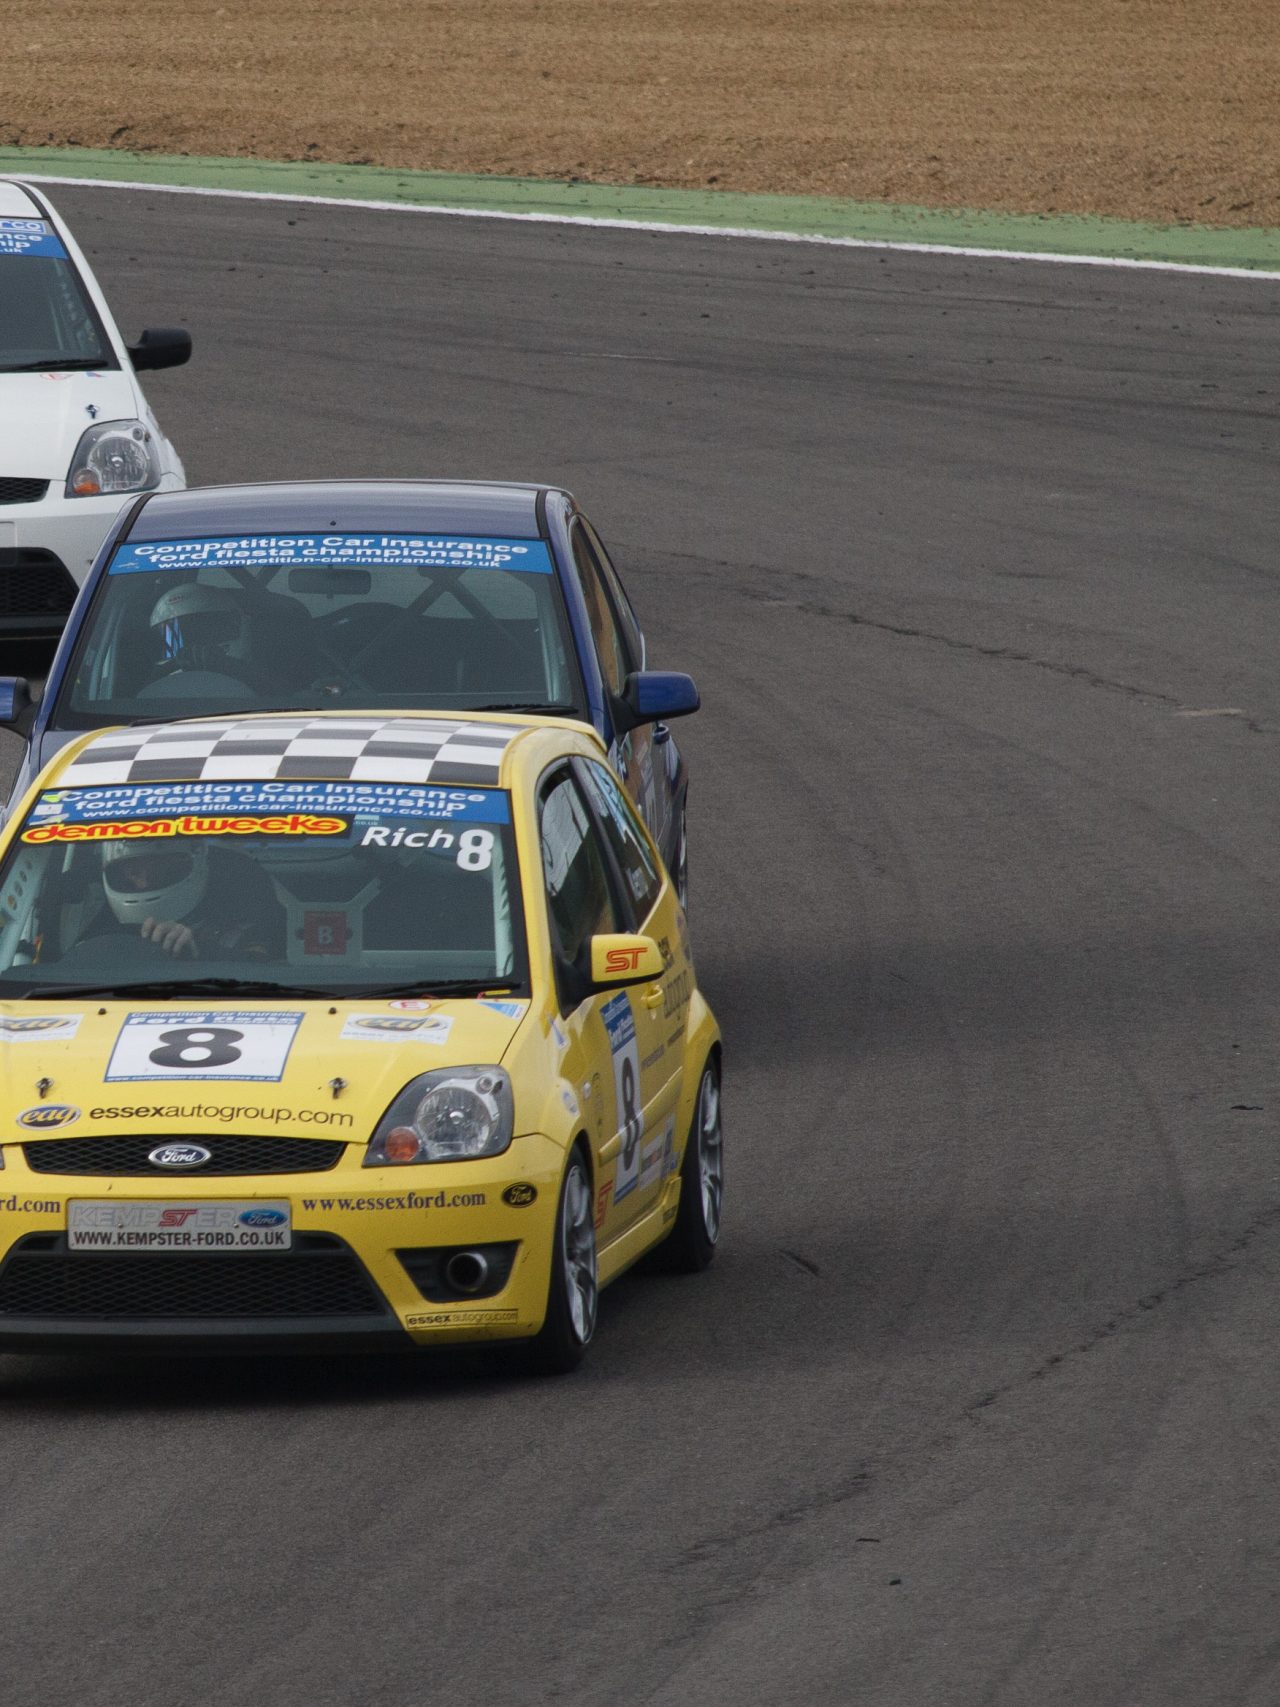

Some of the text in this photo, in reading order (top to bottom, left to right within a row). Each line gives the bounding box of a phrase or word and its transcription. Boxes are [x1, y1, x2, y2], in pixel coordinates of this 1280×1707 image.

[134, 537, 528, 556] Competition Car Insurance
[149, 547, 511, 562] ford fiesta championship
[158, 556, 501, 569] www.competition-car-insurance.co.uk
[62, 783, 486, 802] Competition Car Insurance
[75, 792, 466, 811] ford fiesta championship
[83, 802, 453, 818] www.competition-car-insurance.co.uk
[23, 815, 346, 842] demon tweeks
[605, 947, 648, 973] ST
[149, 1027, 244, 1068] 8
[89, 1103, 354, 1127] essexautogroup.com
[621, 1056, 639, 1171] 8
[303, 1191, 487, 1211] www.essexford.com
[74, 1231, 285, 1246] WWW.KEMPSTER-FORD.CO.UK
